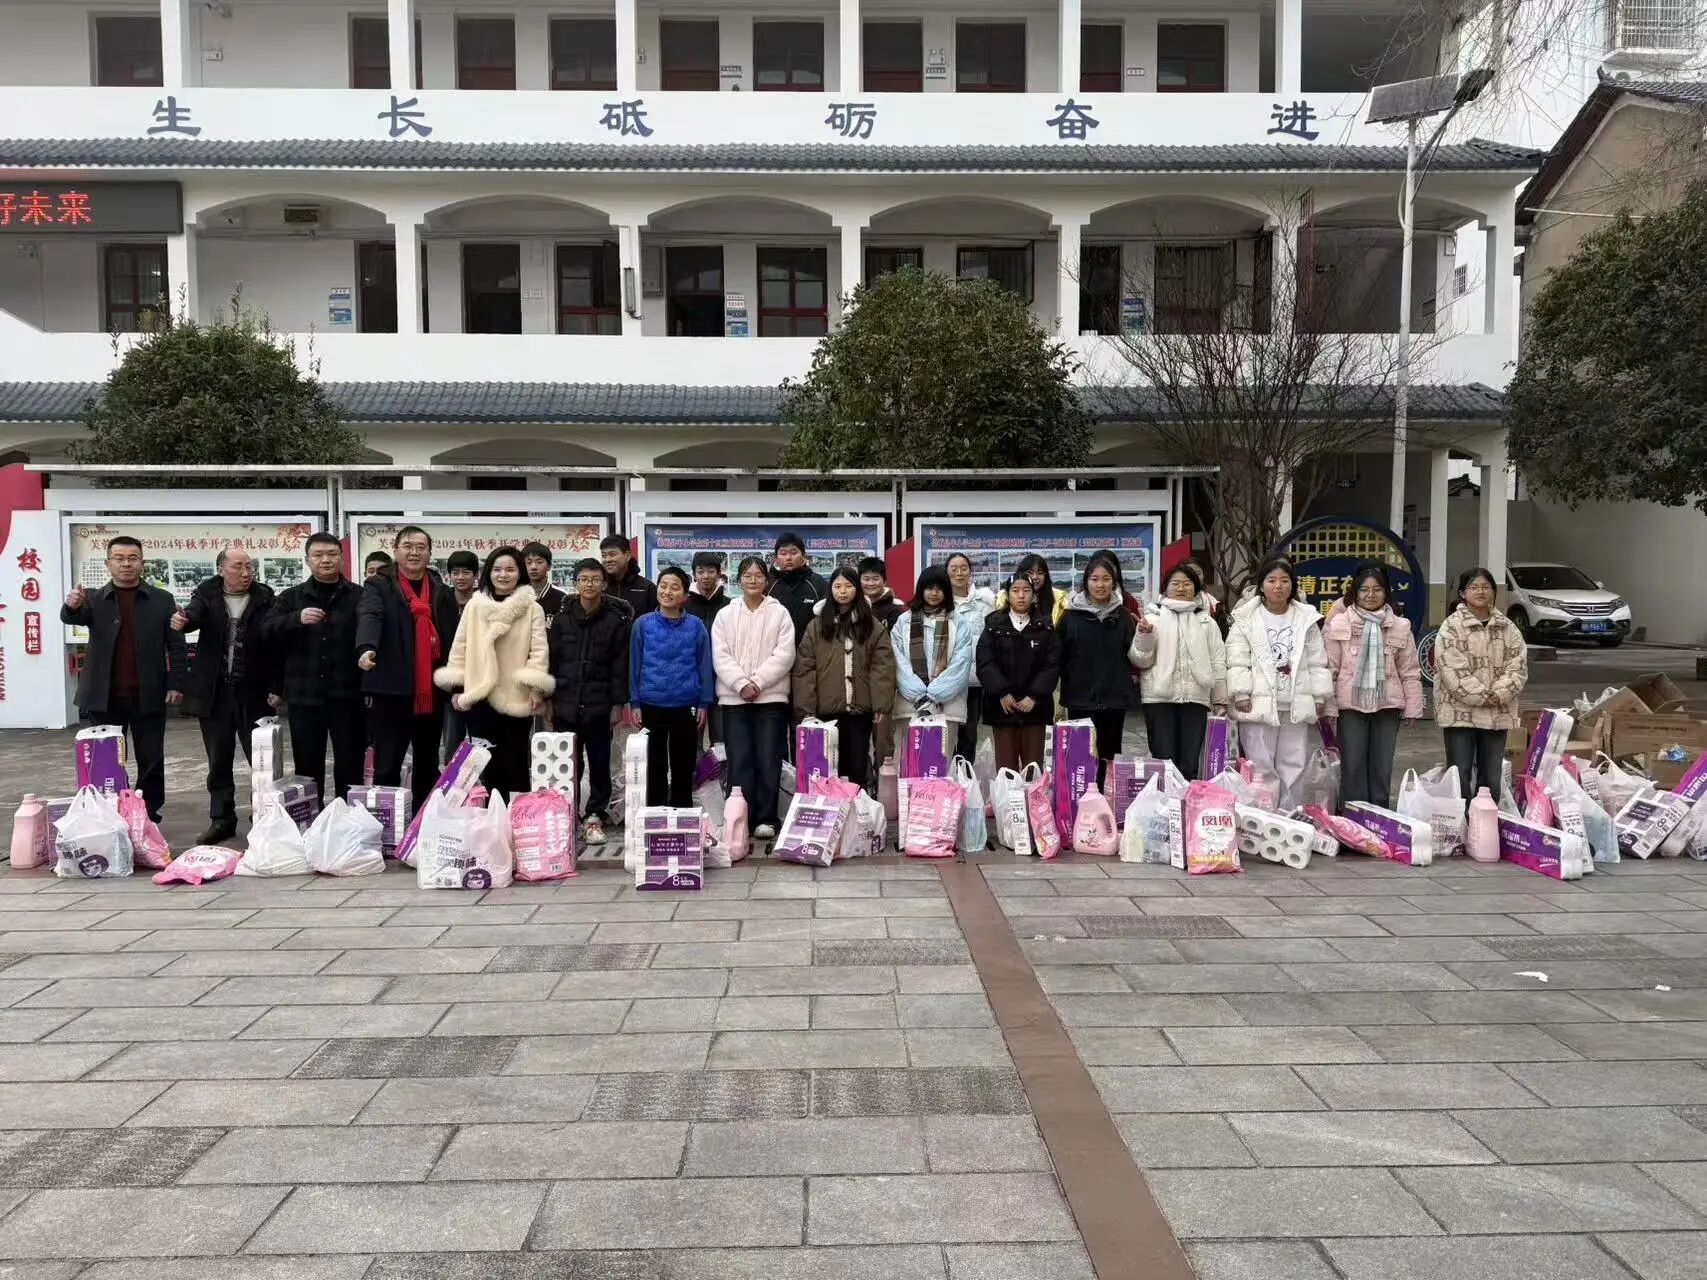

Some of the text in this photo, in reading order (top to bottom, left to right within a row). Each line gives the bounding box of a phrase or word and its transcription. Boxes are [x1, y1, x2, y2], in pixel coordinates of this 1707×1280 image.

[17, 548, 42, 601] 校园
[26, 614, 40, 652] 宣传栏
[1013, 813, 1019, 823] 8
[1201, 815, 1233, 828] 凤凰
[801, 844, 808, 855] 8
[672, 875, 680, 886] 8
